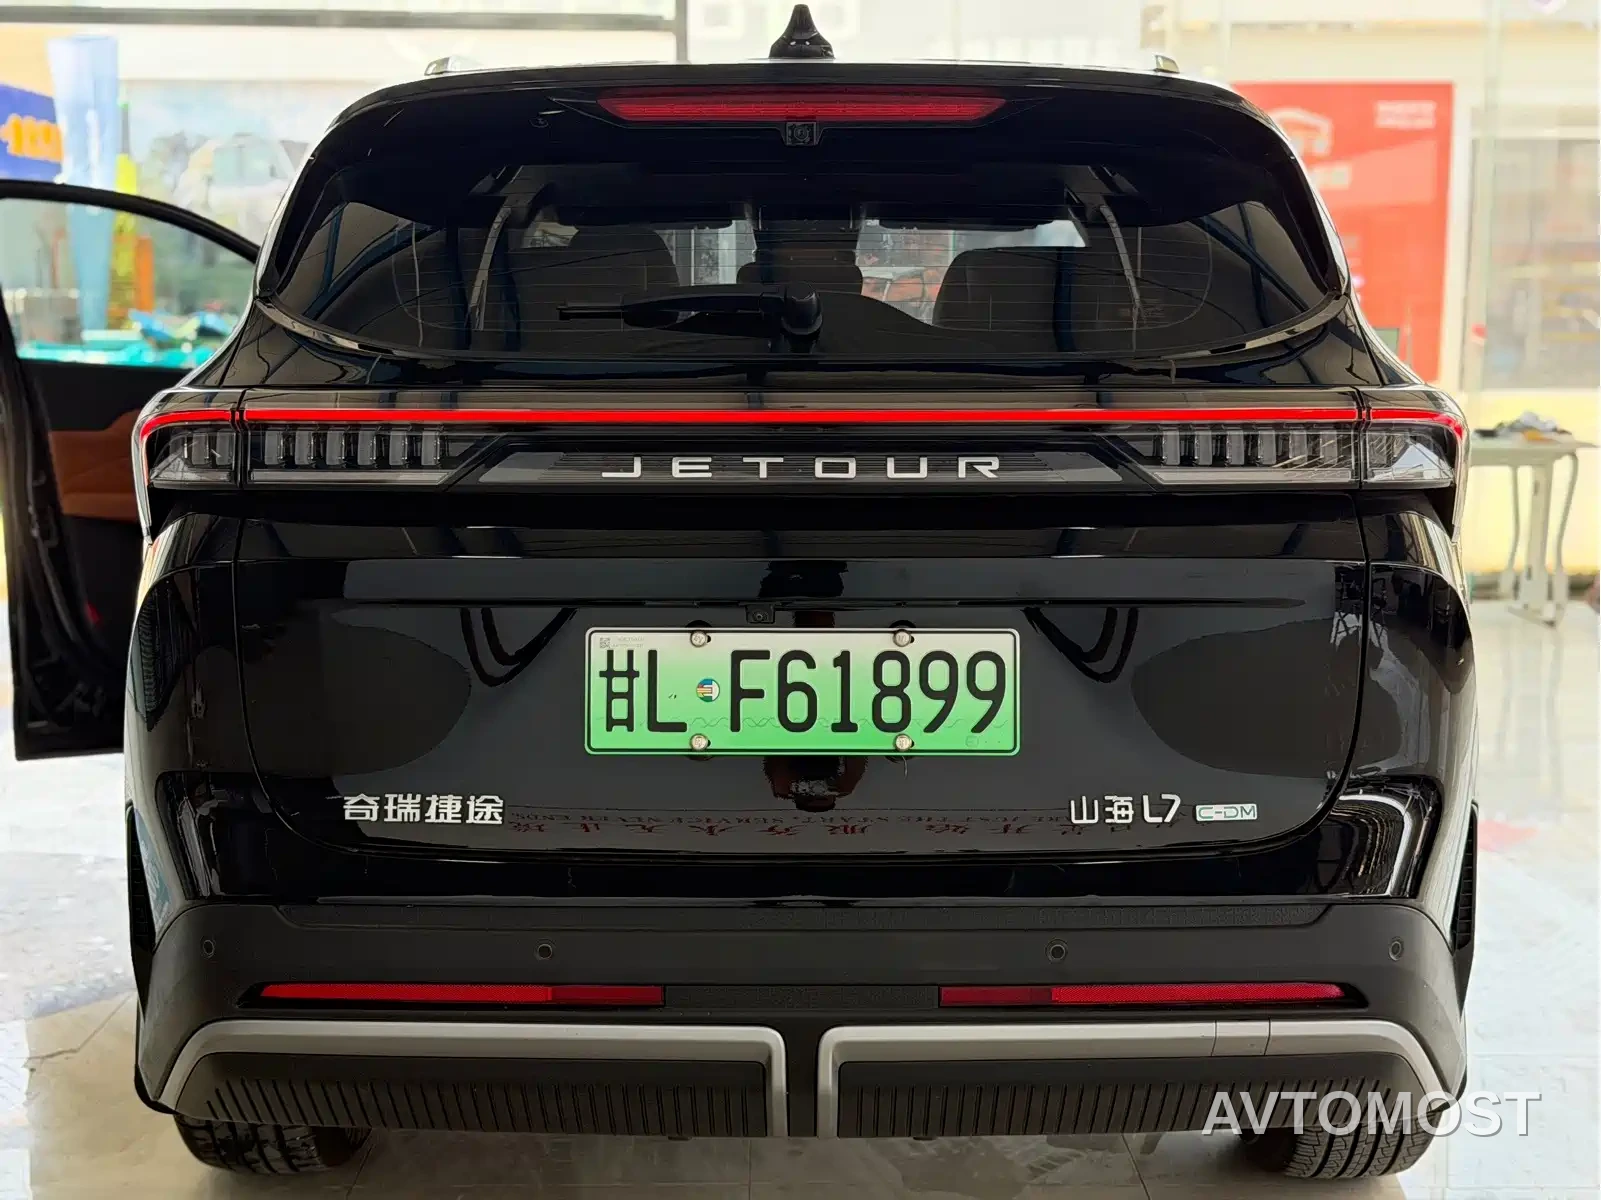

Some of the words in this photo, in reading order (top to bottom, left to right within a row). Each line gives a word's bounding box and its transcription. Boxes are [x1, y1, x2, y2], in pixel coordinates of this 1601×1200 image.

[601, 456, 1000, 479] JETOUR
[729, 649, 1006, 734] F61899
[343, 793, 503, 824] 奇瑞捷途
[1198, 806, 1256, 820] C-DM
